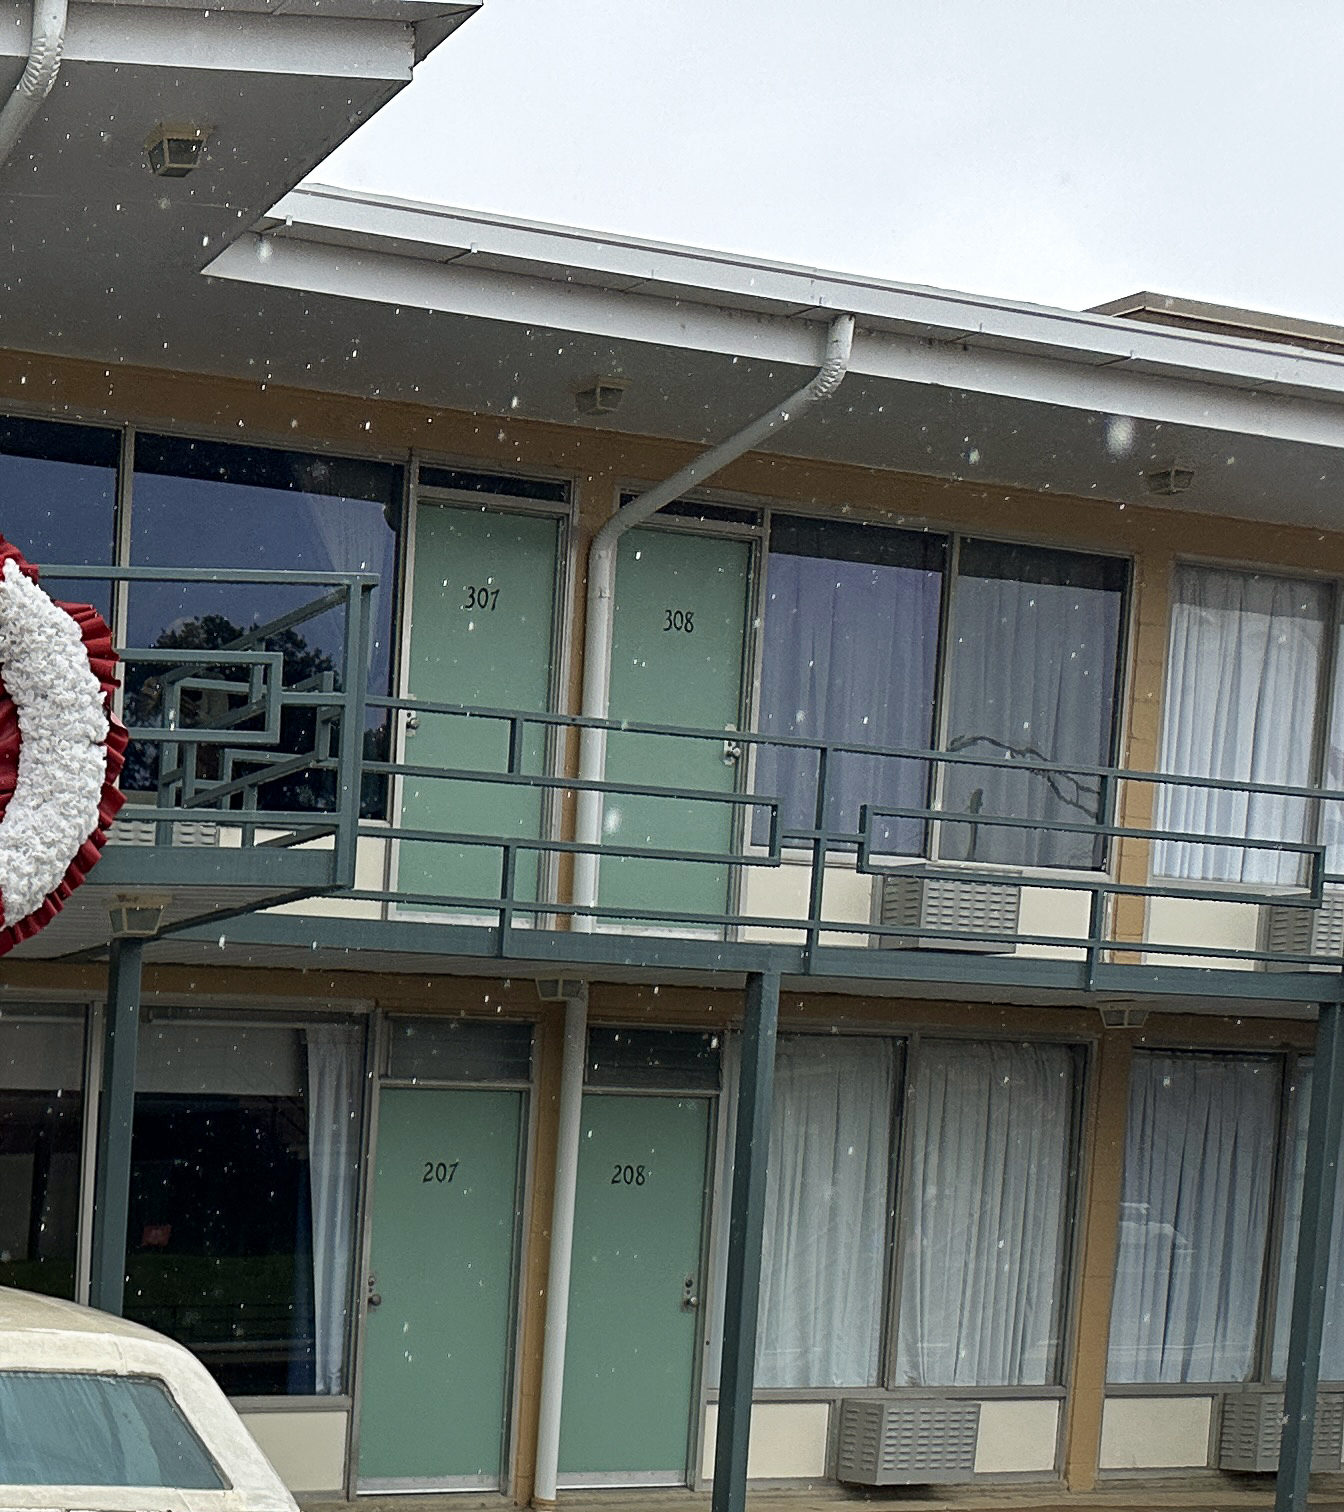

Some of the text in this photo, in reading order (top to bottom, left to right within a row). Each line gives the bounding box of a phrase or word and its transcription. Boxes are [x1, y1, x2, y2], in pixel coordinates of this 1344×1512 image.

[465, 586, 499, 611] 307
[664, 610, 694, 633] 308
[423, 1162, 458, 1182] 207
[611, 1165, 645, 1185] 208
